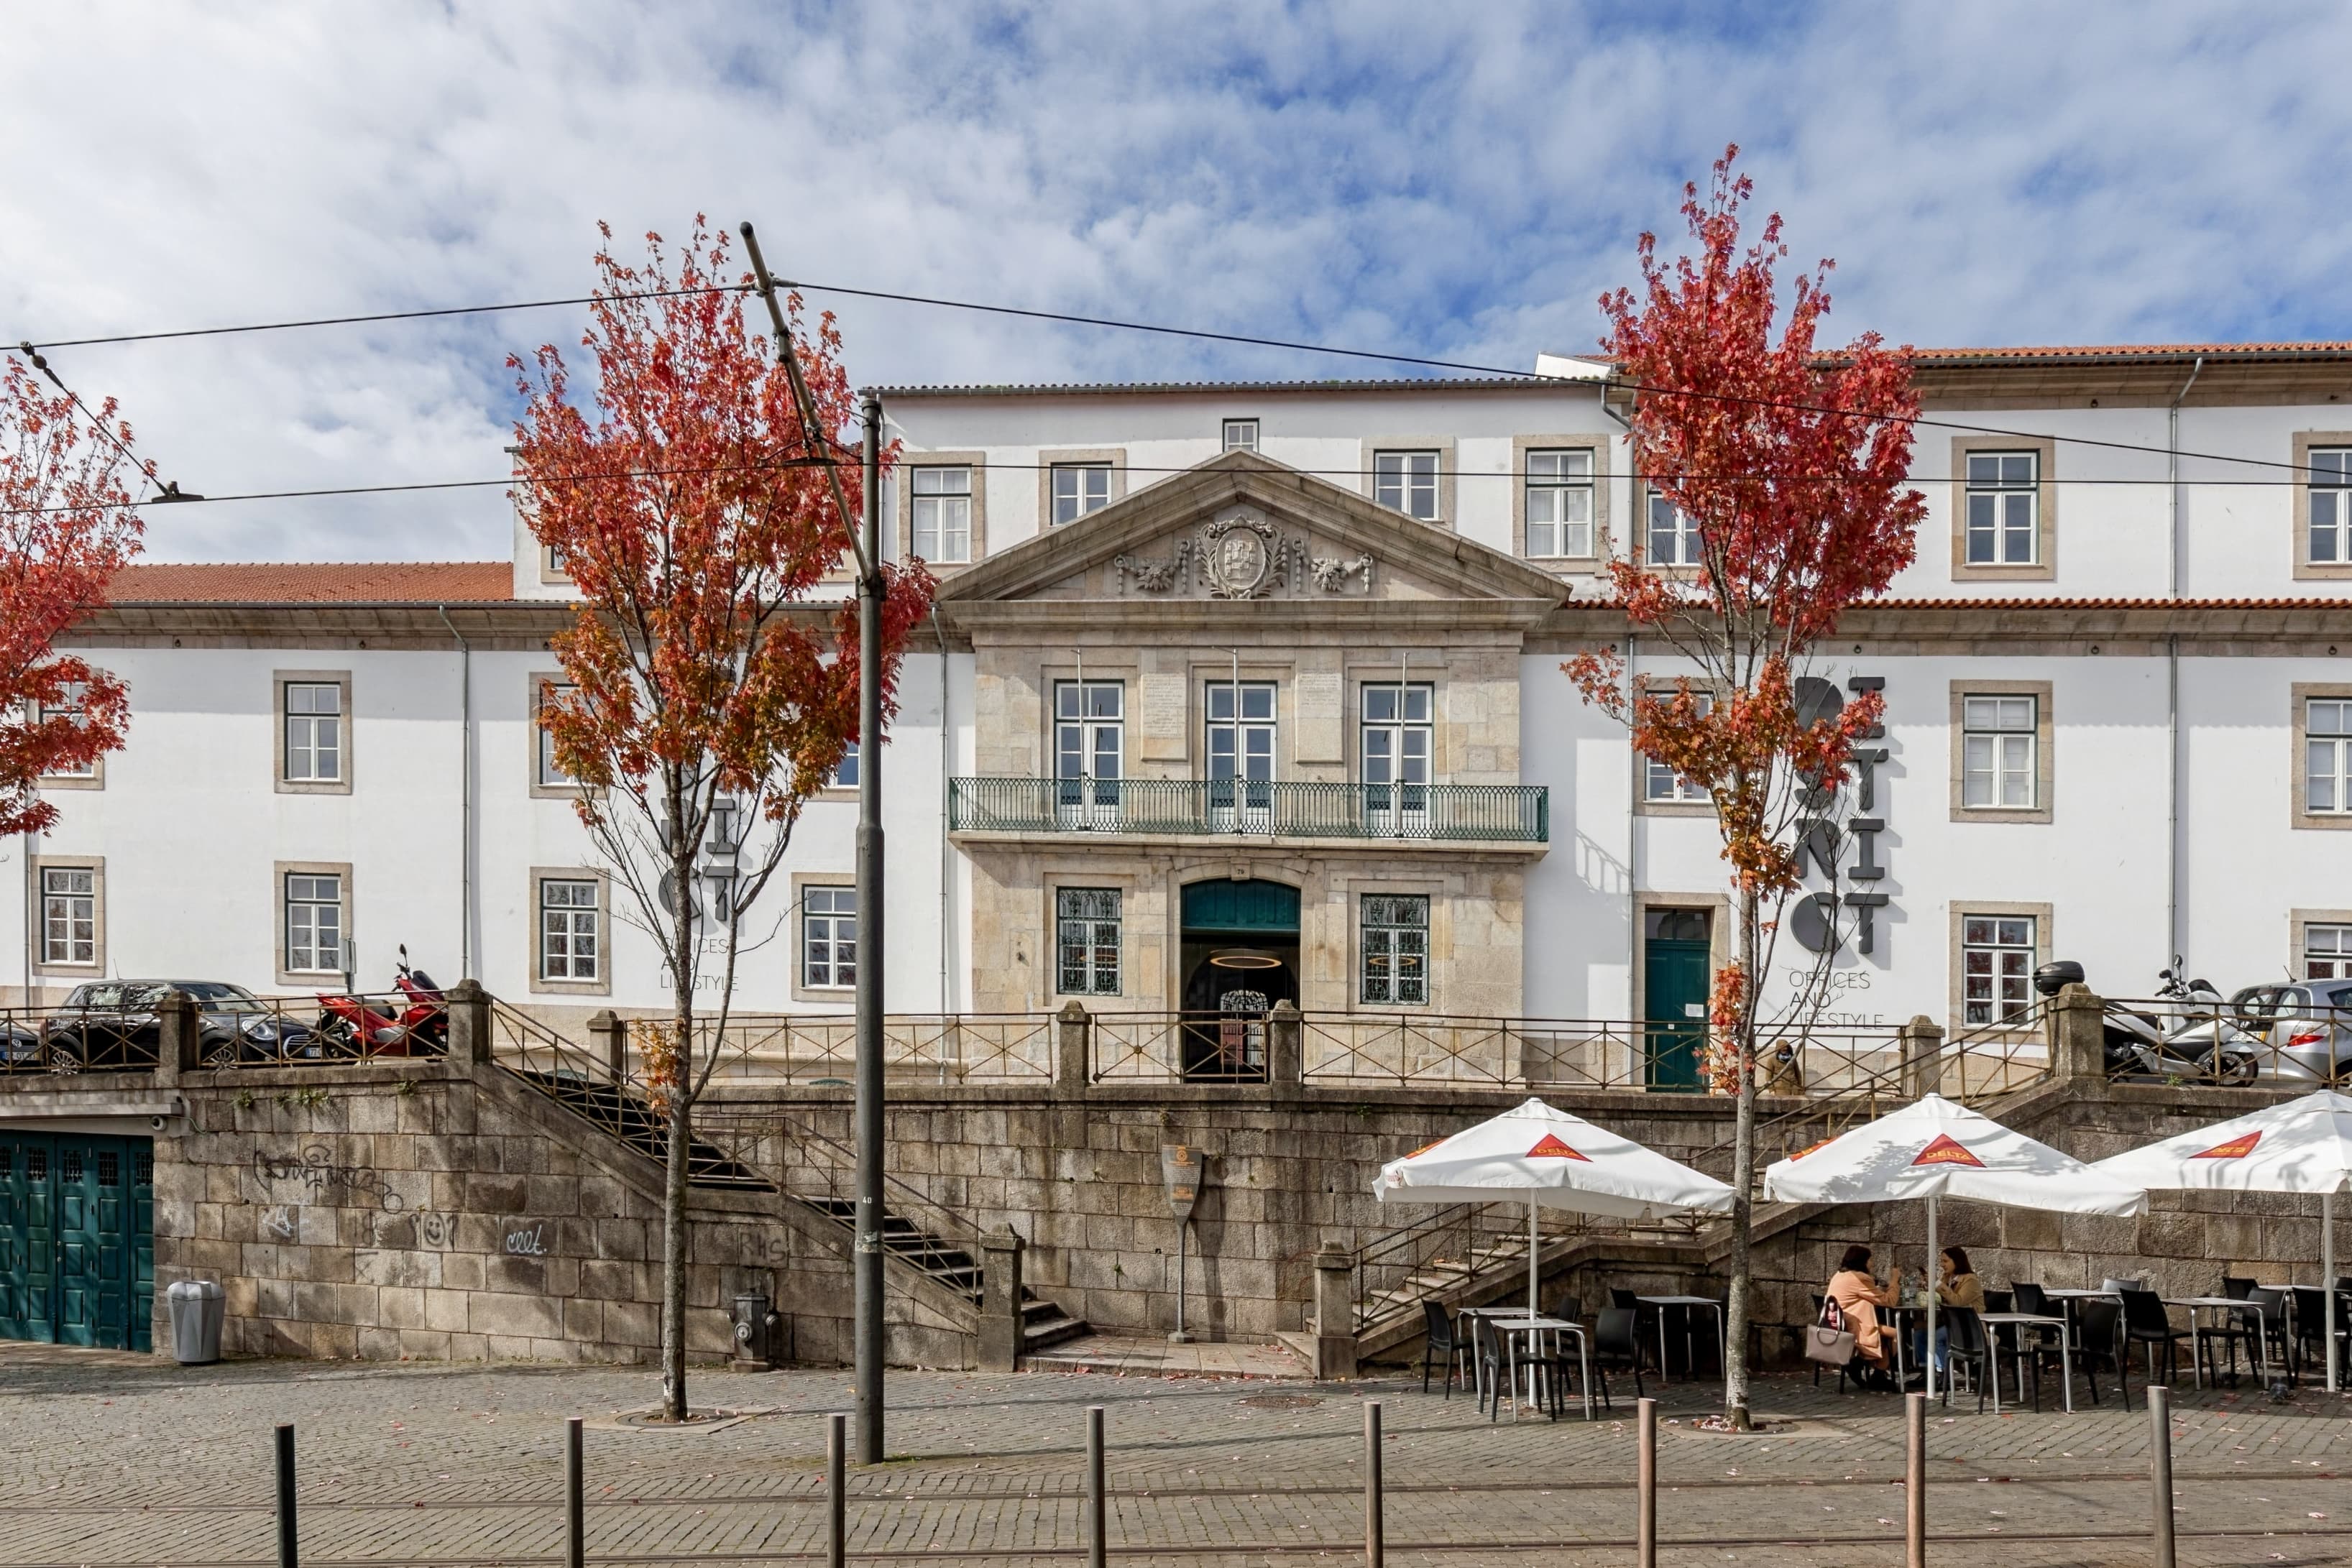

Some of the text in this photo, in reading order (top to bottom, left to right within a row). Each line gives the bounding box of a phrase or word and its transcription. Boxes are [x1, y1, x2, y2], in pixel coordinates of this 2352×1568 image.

[661, 936, 728, 954] OICES
[661, 974, 739, 991] LISTYLE
[1788, 971, 1871, 990] OFFICES
[1790, 991, 1832, 1009] AND
[1926, 1150, 1972, 1161] DELTA
[863, 1196, 872, 1204] 40
